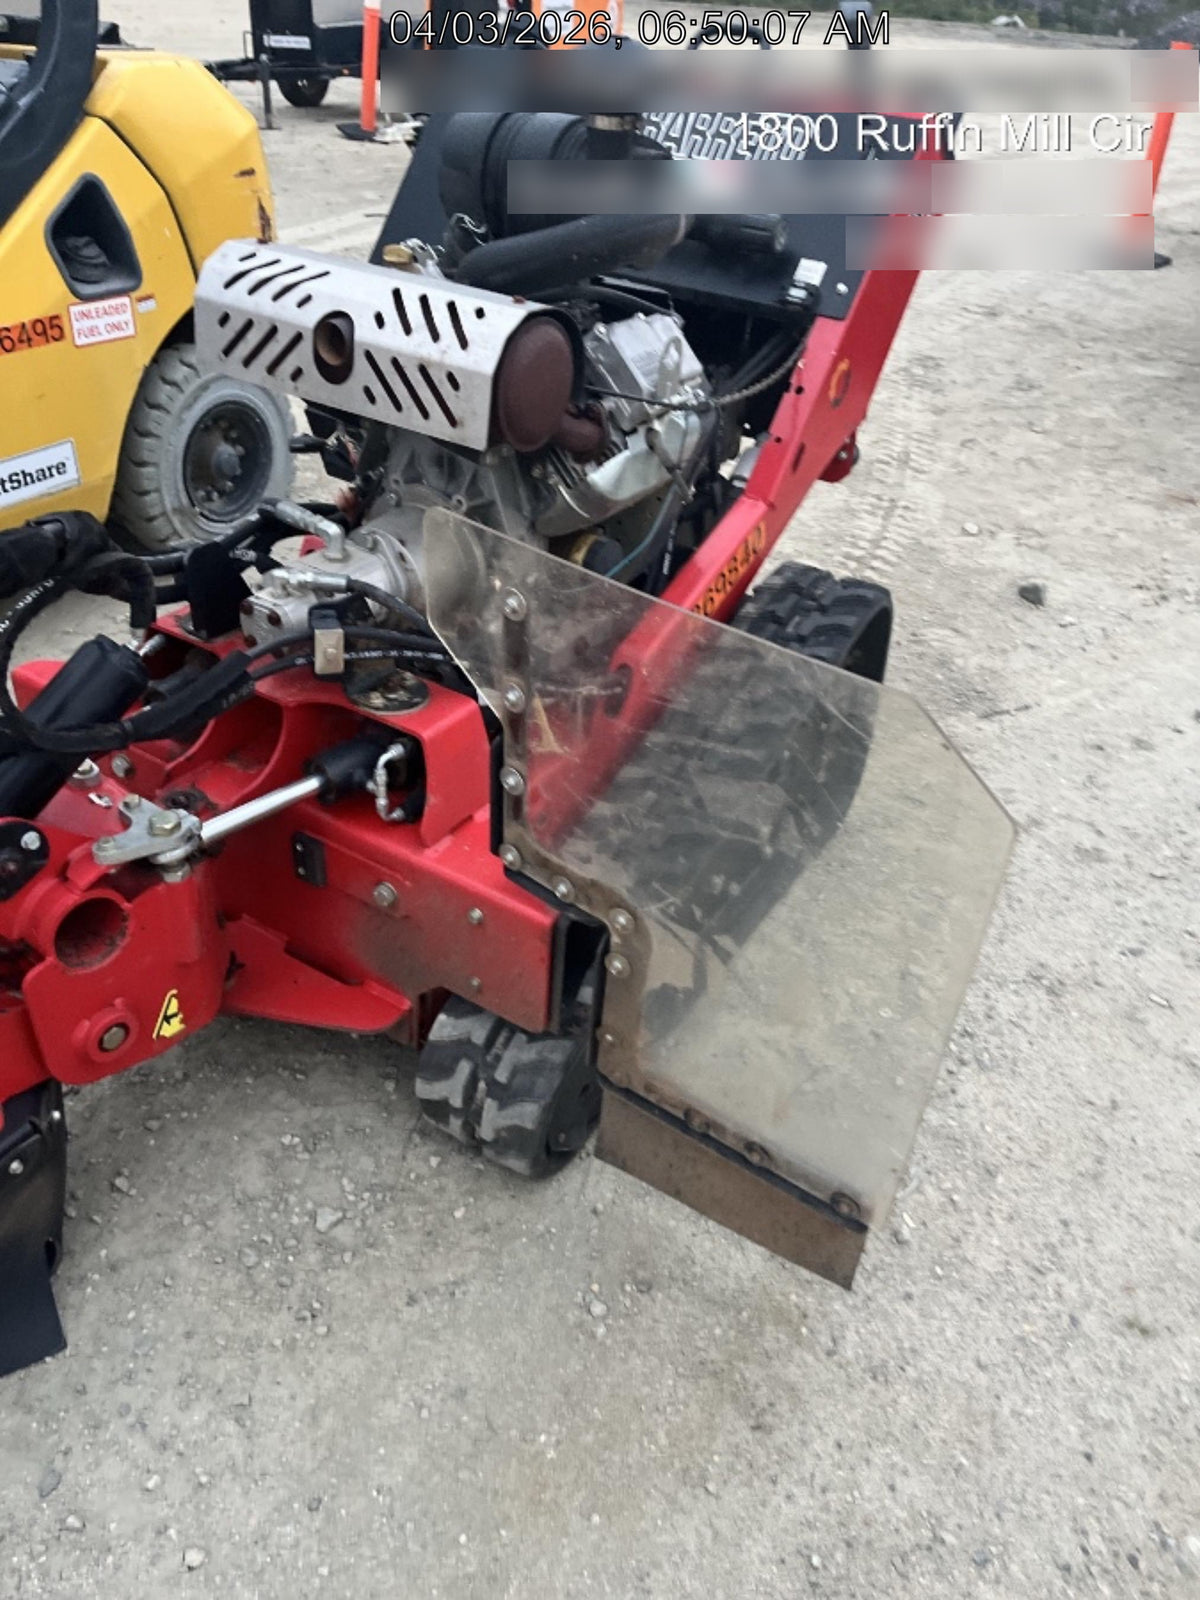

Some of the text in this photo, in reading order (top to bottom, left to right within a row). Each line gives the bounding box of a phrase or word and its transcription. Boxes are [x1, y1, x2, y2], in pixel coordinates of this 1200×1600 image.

[73, 302, 128, 322] UNLEADED
[76, 319, 130, 340] FUEL ONLY
[0, 461, 67, 495] tShare
